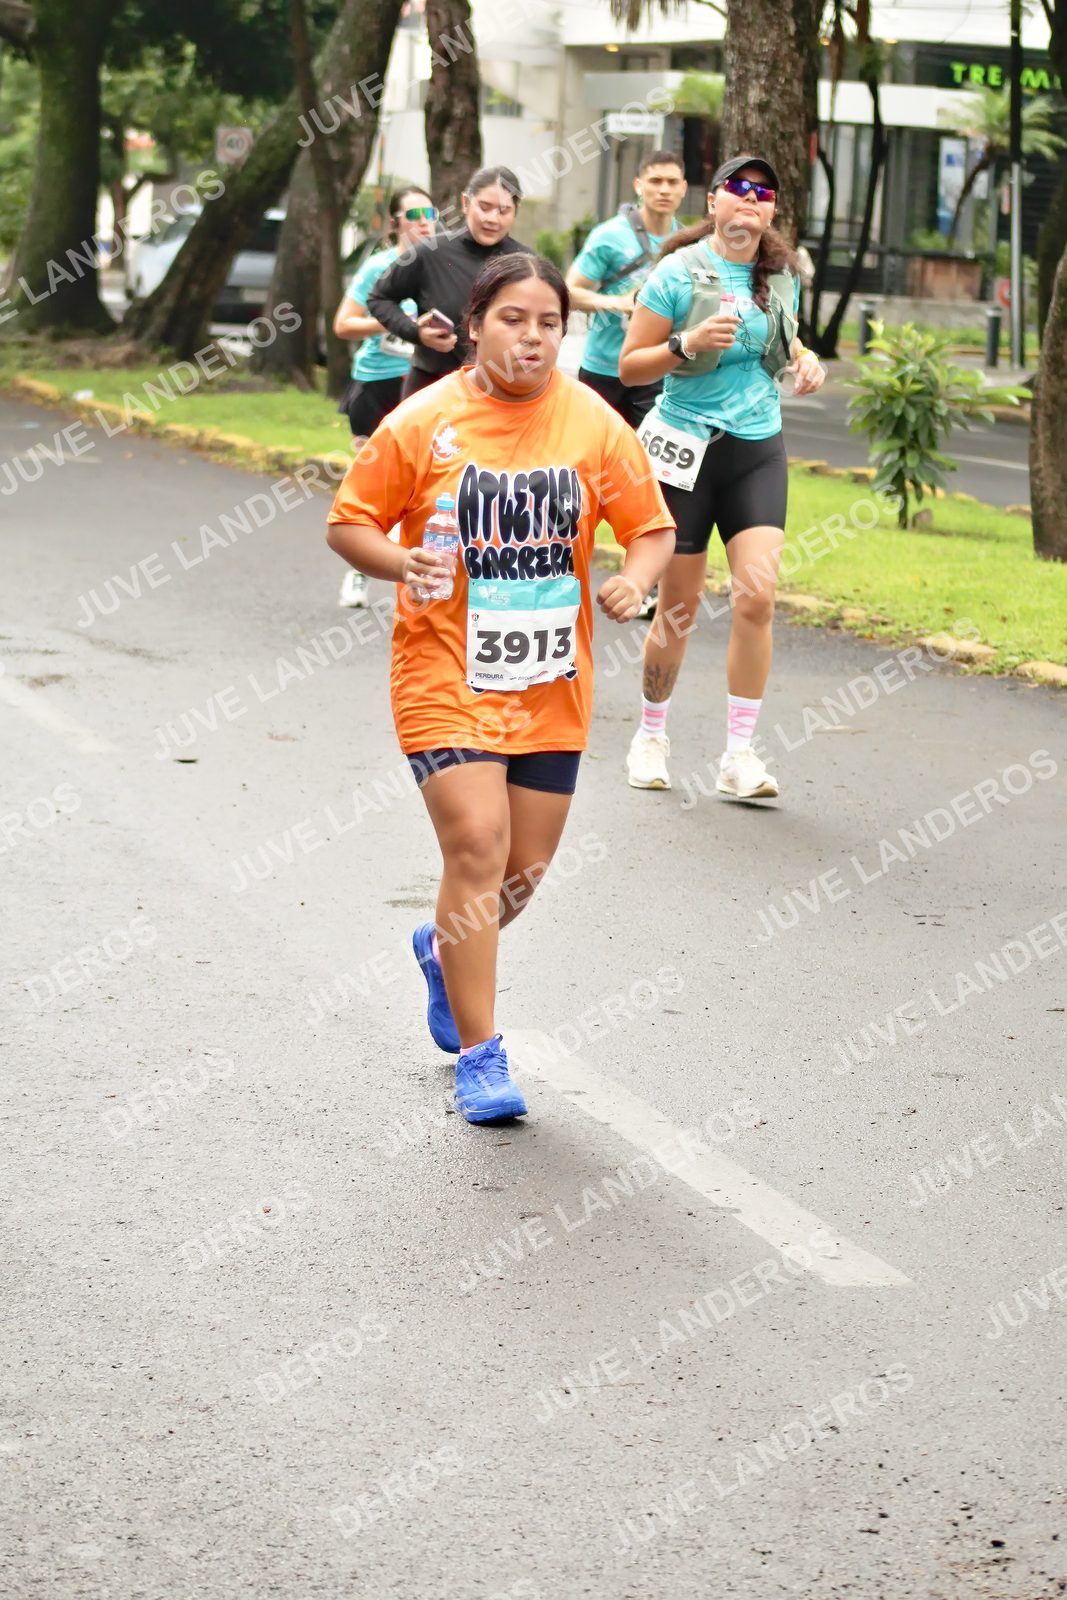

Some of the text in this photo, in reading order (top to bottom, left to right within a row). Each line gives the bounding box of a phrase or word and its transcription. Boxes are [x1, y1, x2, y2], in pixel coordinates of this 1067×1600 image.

[463, 543, 575, 581] BARRERA
[475, 627, 572, 664] 3913
[474, 672, 504, 680] PERDURA
